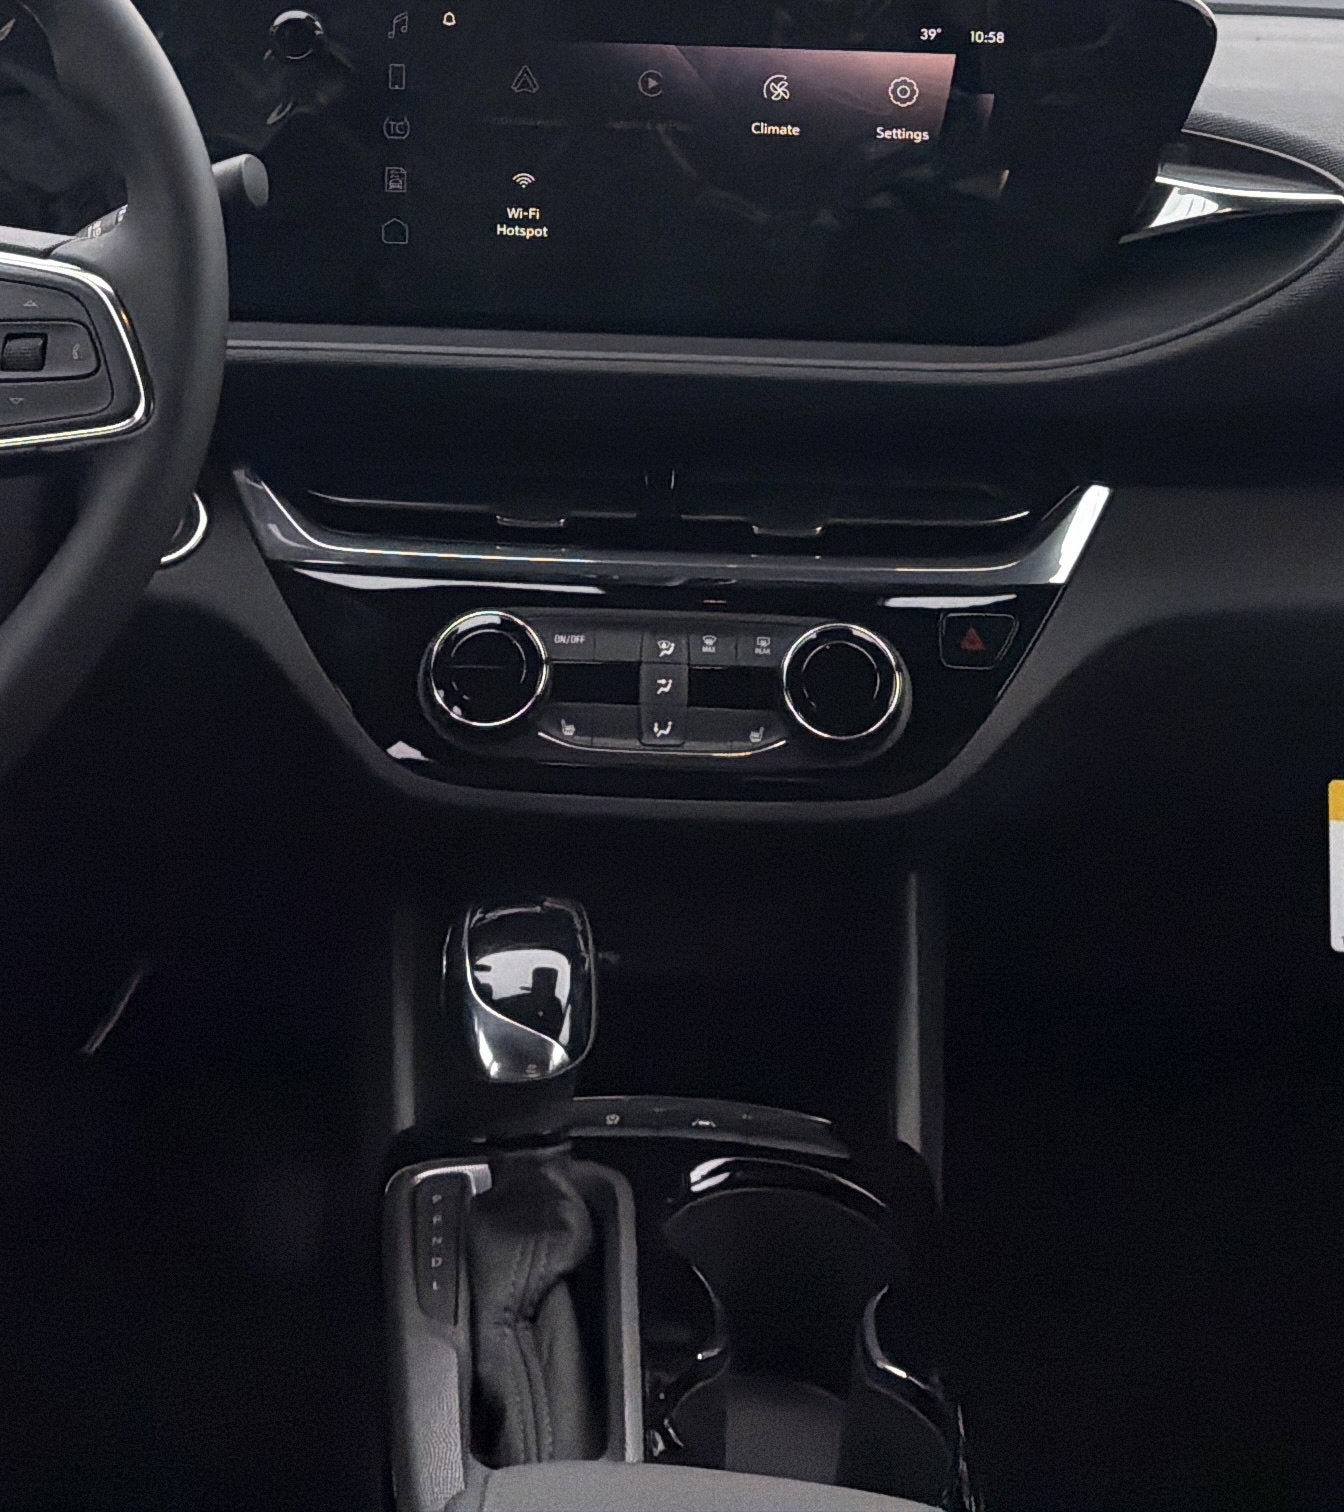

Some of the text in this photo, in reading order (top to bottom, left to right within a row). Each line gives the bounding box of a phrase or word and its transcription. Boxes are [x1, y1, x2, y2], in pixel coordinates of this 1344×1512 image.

[970, 30, 1005, 44] 10:58
[388, 121, 405, 134] TC
[751, 121, 800, 136] Climate
[876, 126, 930, 143] Settings
[507, 207, 540, 220] Wi-Fi
[496, 224, 549, 239] Hotspot
[554, 634, 586, 645] ON/OFF
[431, 1257, 443, 1268] D
